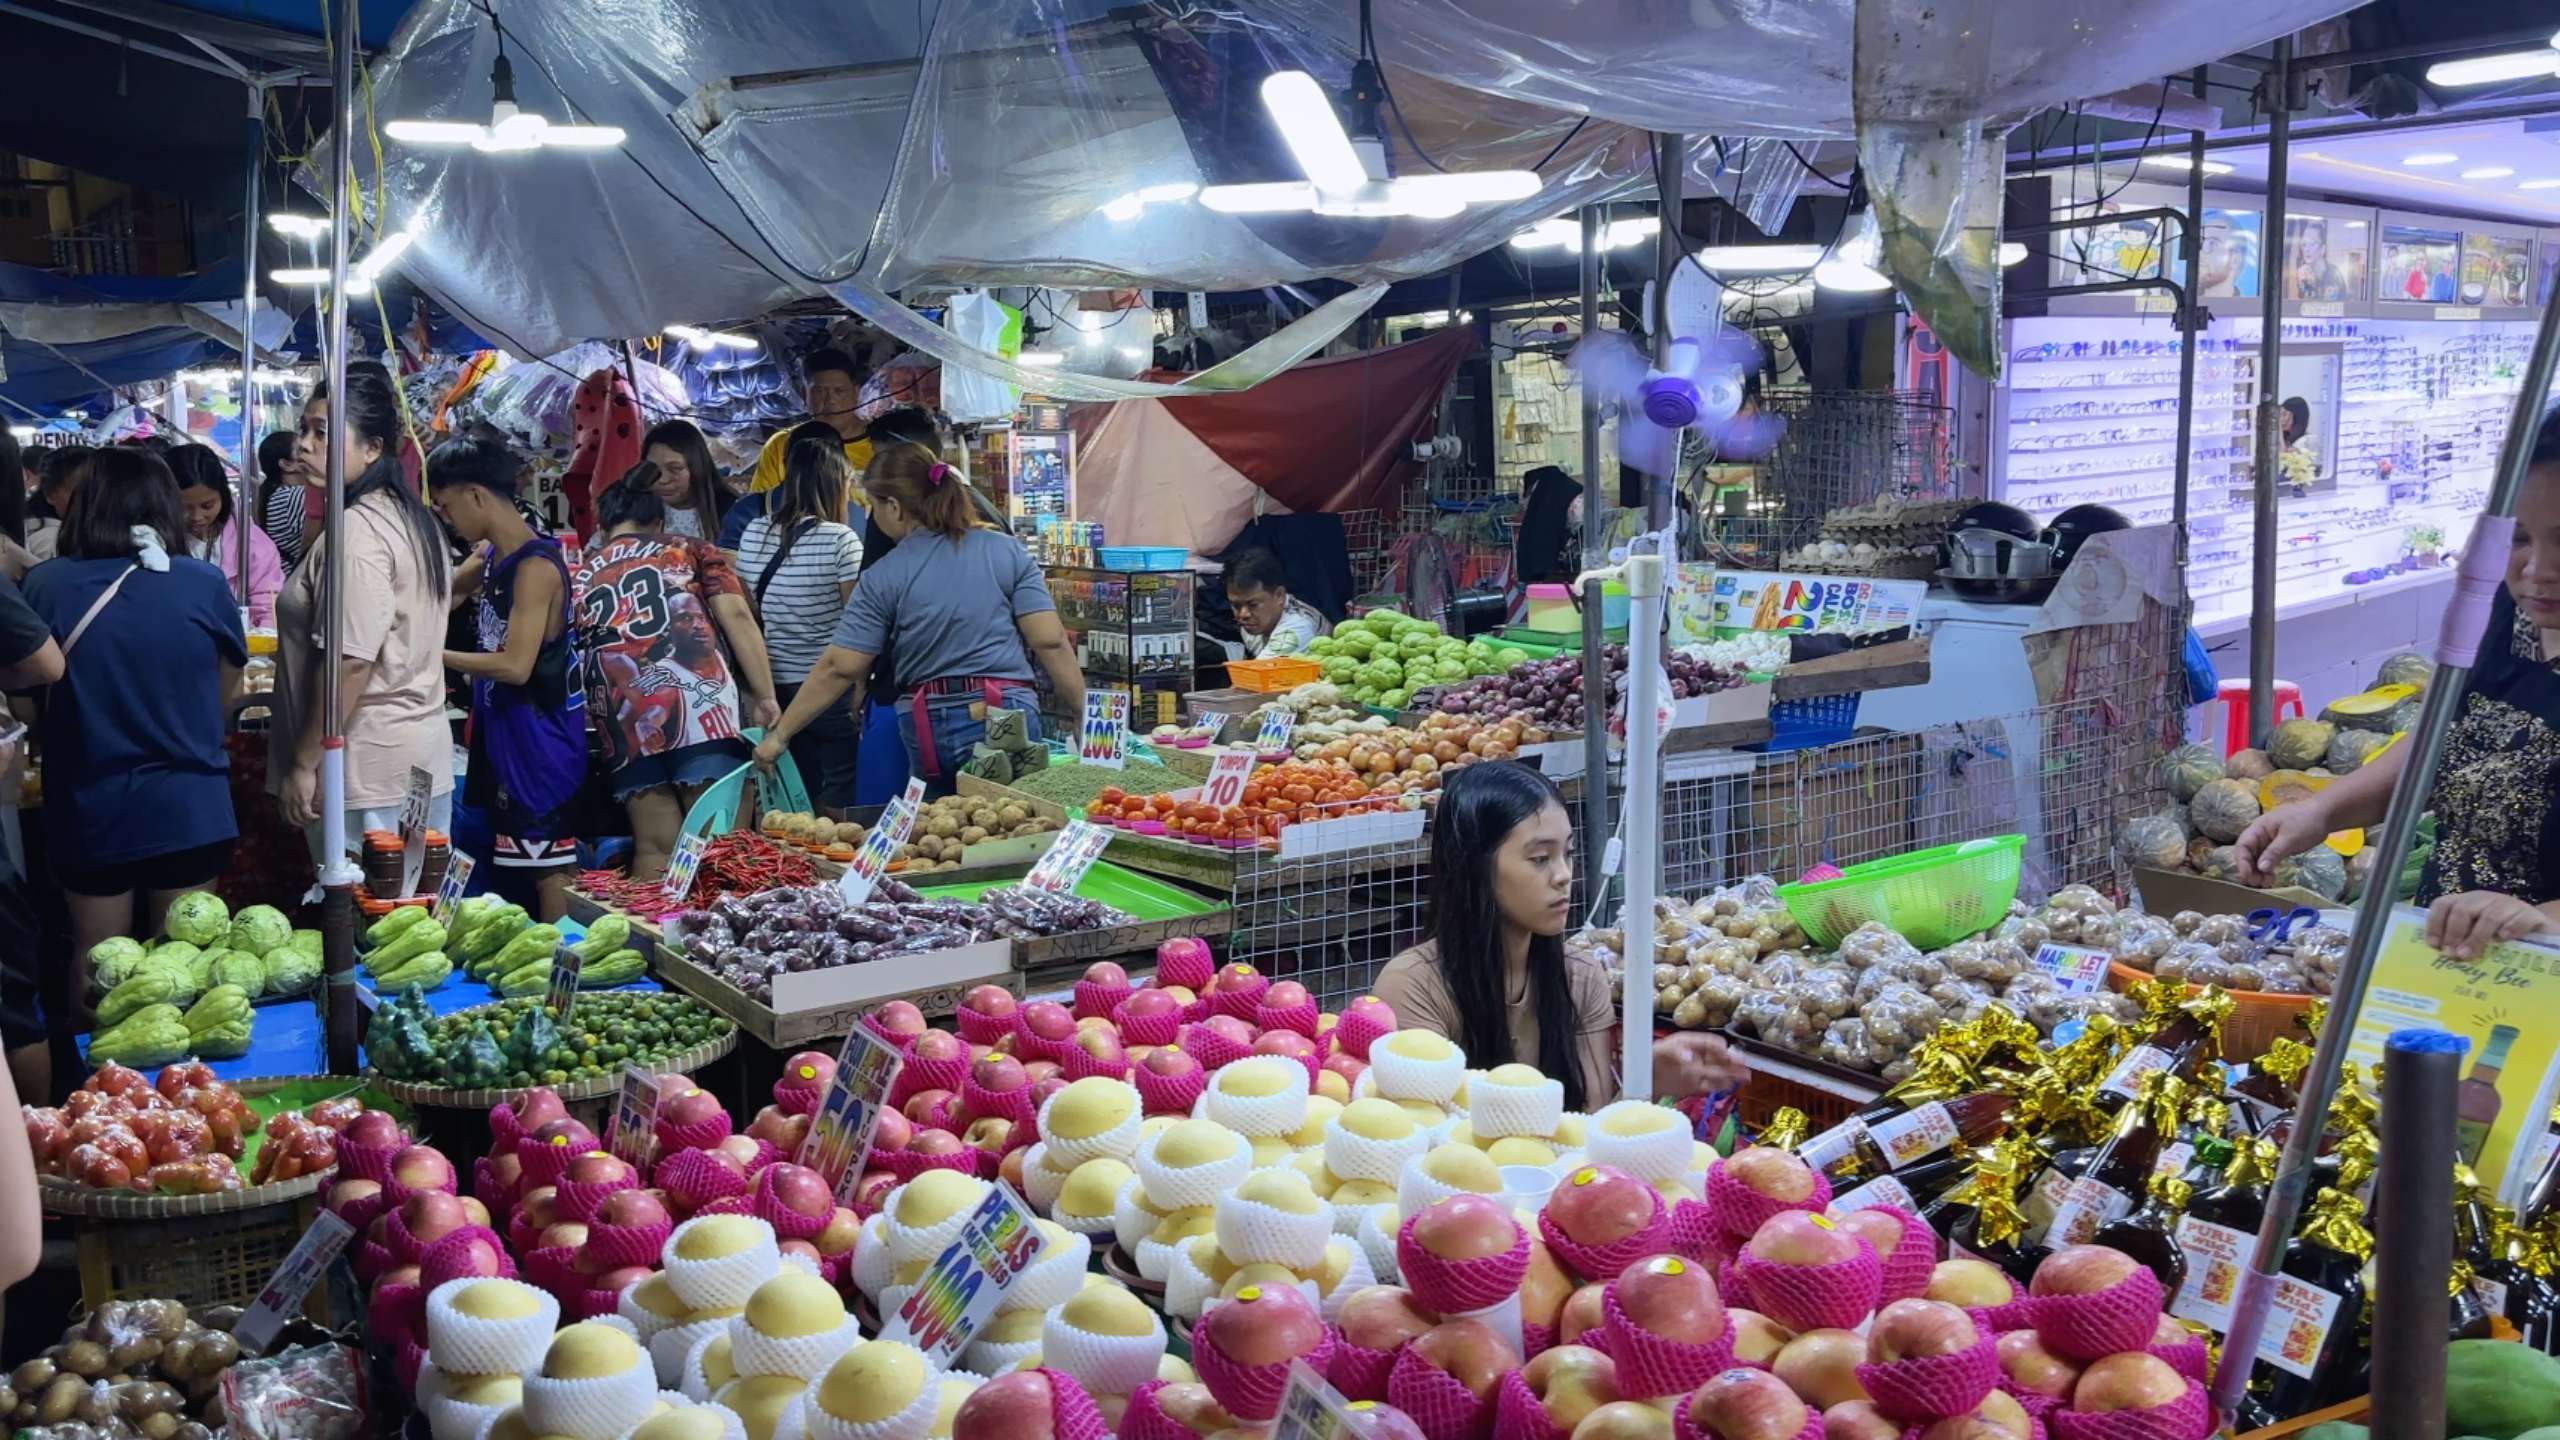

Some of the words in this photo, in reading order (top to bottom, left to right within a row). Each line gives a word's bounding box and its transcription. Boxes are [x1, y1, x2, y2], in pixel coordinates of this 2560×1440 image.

[570, 540, 664, 595] JORDAN
[582, 564, 671, 652] 23
[1083, 720, 1114, 760] 100
[1208, 774, 1240, 806] 10
[852, 831, 889, 881] 10
[803, 1084, 863, 1192] 50
[838, 1108, 876, 1200] TUMPOK
[972, 1189, 1041, 1273] PERAS
[2186, 1221, 2239, 1246] PURE
